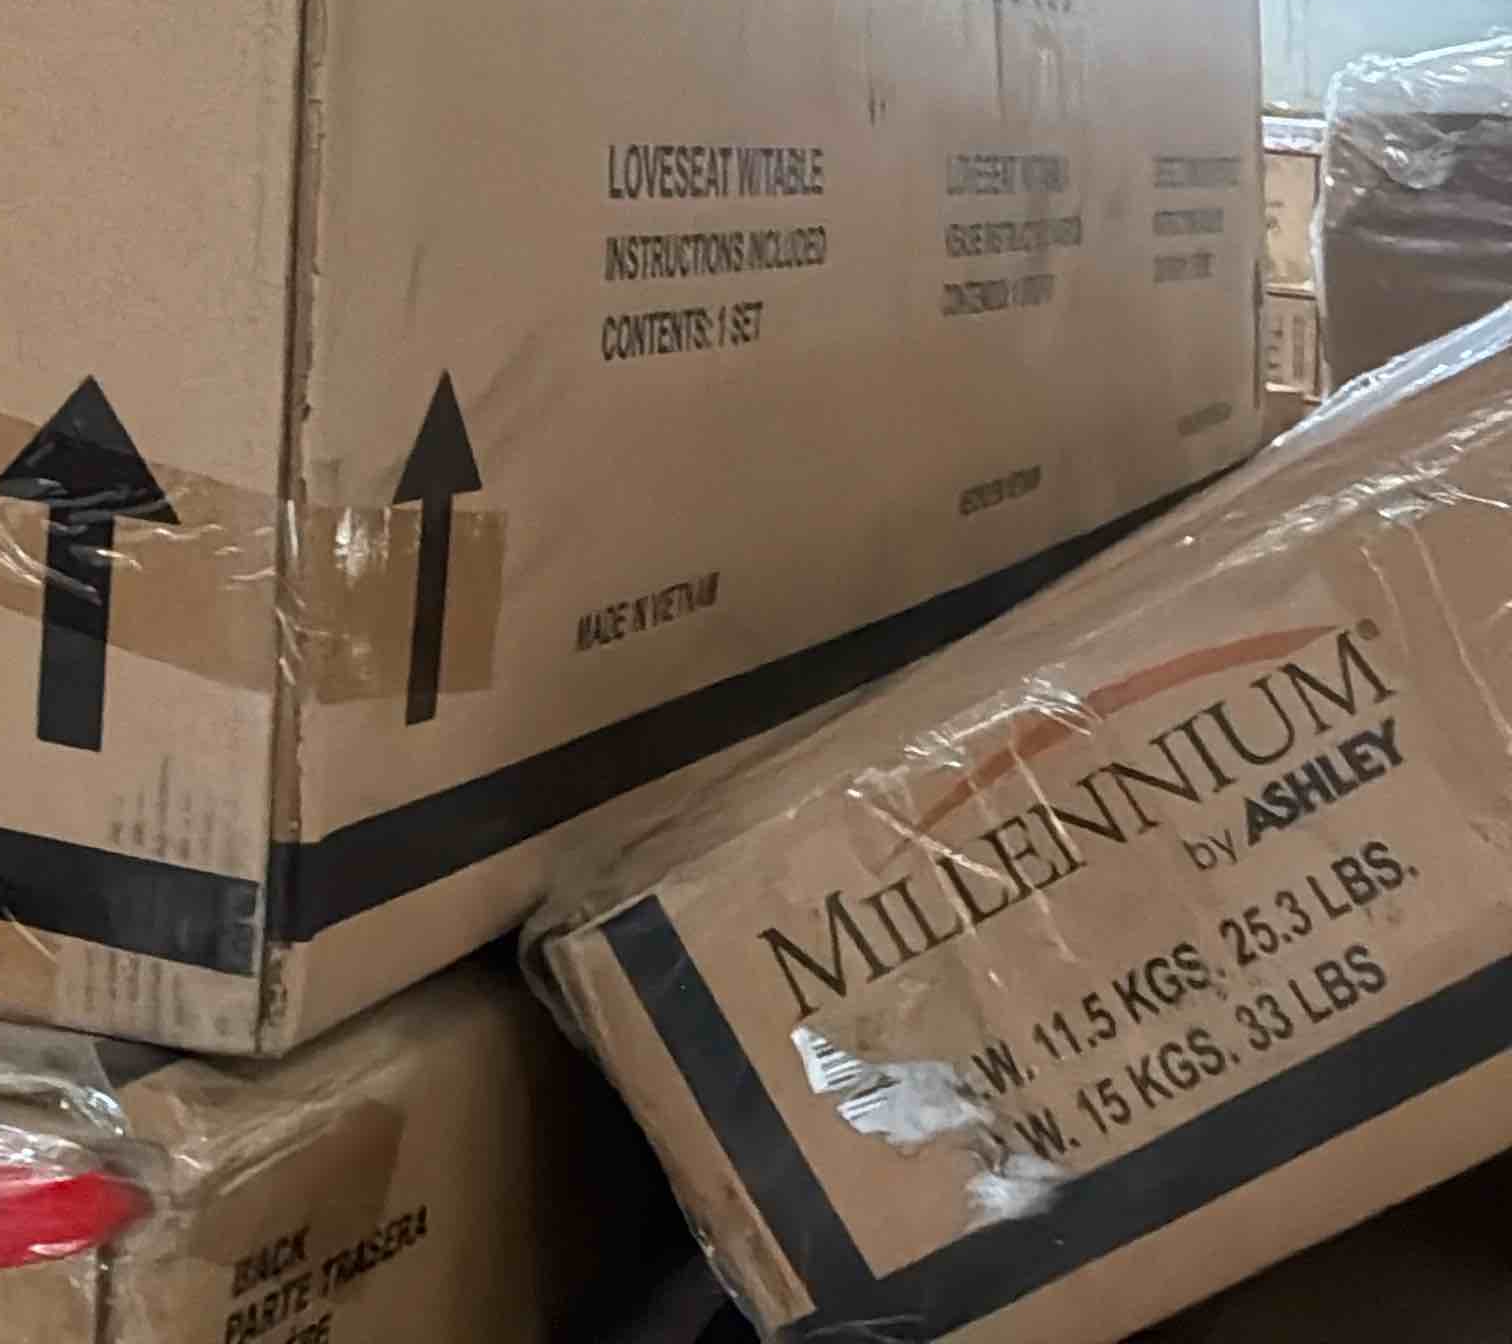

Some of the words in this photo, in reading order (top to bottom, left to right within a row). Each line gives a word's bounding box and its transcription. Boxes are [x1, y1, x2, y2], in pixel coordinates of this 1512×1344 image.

[607, 143, 734, 200] LOVESEAT
[604, 230, 745, 282] INSTRUCTIONS
[747, 224, 828, 270] INCLUDED
[730, 300, 764, 346] SET
[575, 601, 628, 652] MADE
[631, 594, 649, 632] IN
[650, 571, 721, 628] VIETNAM
[758, 630, 1397, 1023] MILLENNIUM
[1179, 830, 1241, 873] by
[1245, 719, 1404, 846] ASHLEY
[1033, 991, 1119, 1061] 11.5
[1217, 889, 1313, 968] 25.3
[1305, 840, 1421, 921] LBS.
[1076, 1077, 1132, 1135] 15
[1124, 1024, 1242, 1109] KGS.
[1234, 992, 1295, 1052] 33
[1288, 943, 1386, 1024] LBS
[225, 1271, 313, 1344] PARTE
[320, 1204, 428, 1298] TRASERA
[232, 1224, 312, 1299] BACK
